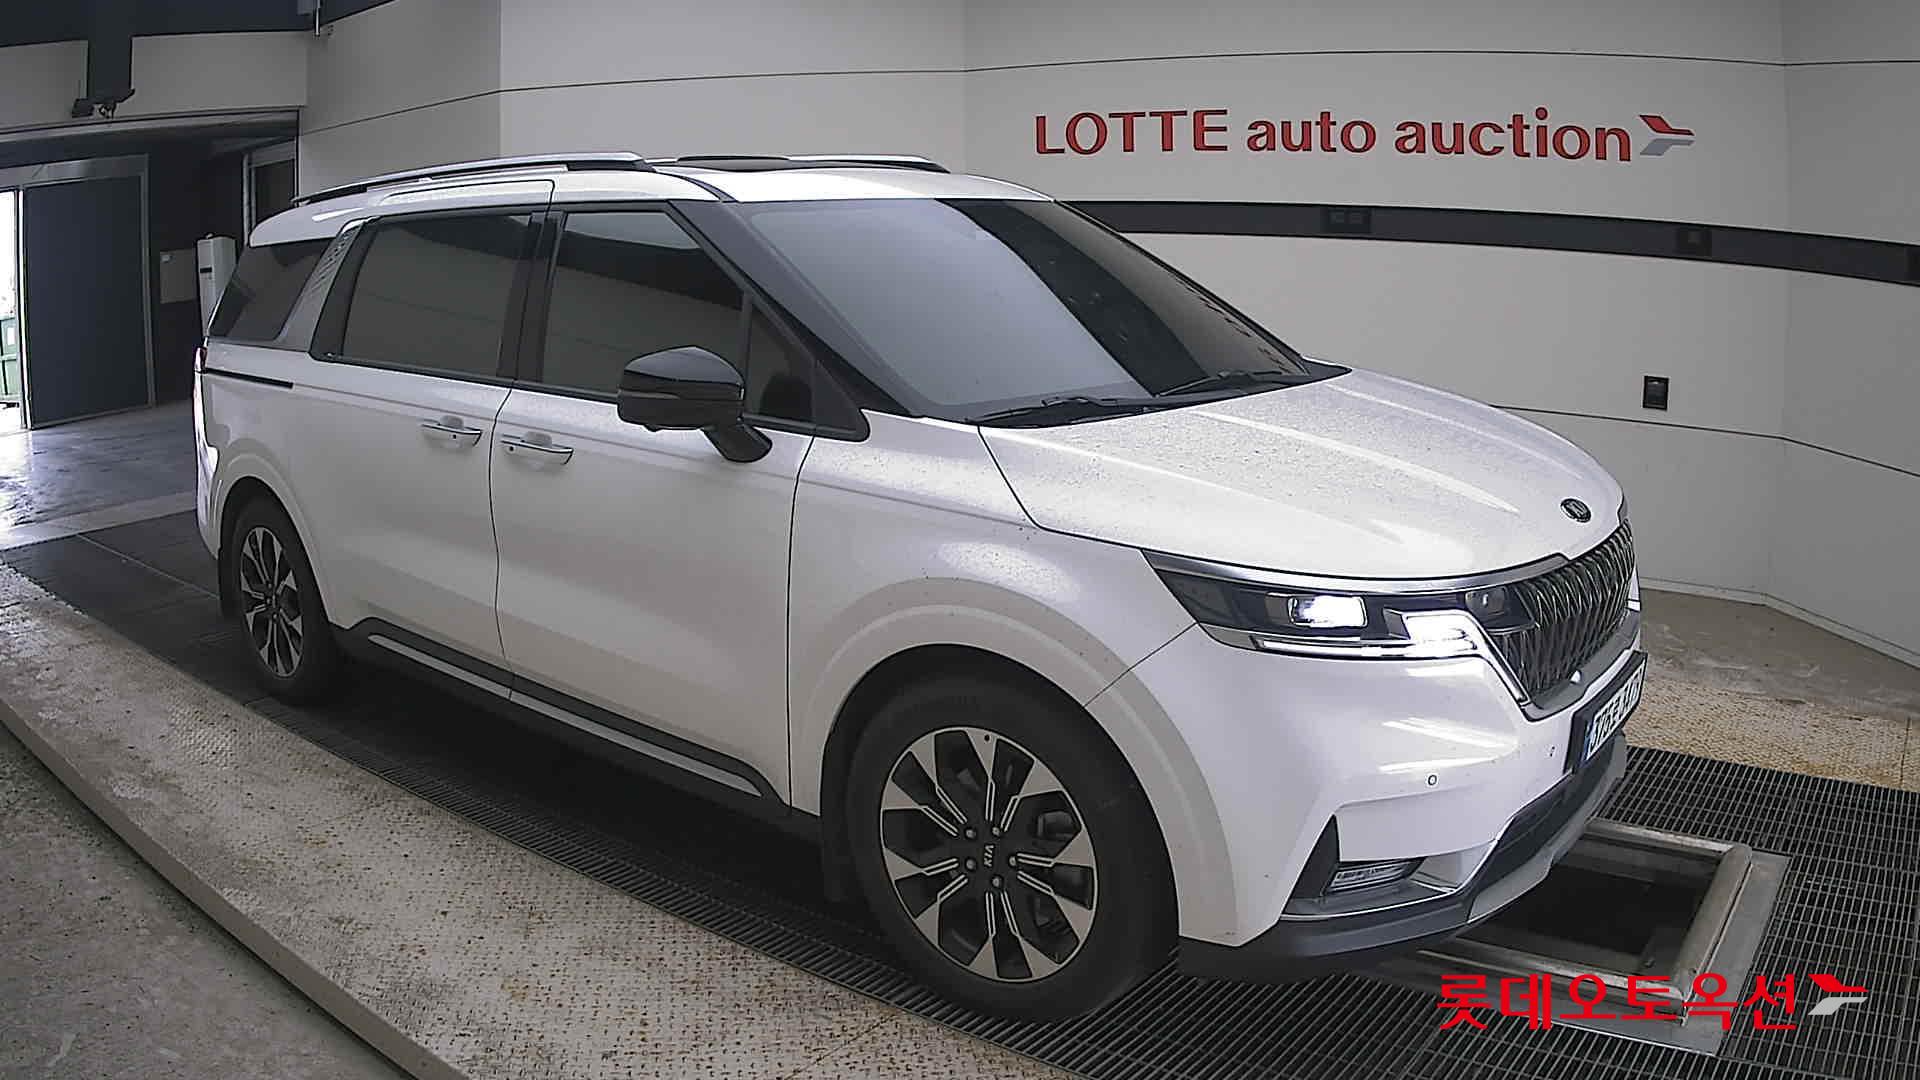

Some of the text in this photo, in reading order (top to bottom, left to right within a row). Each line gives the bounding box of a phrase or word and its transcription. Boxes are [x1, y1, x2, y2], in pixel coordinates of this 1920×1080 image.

[1035, 106, 1632, 161] LOTTE auto auction
[984, 844, 994, 867] KIA
